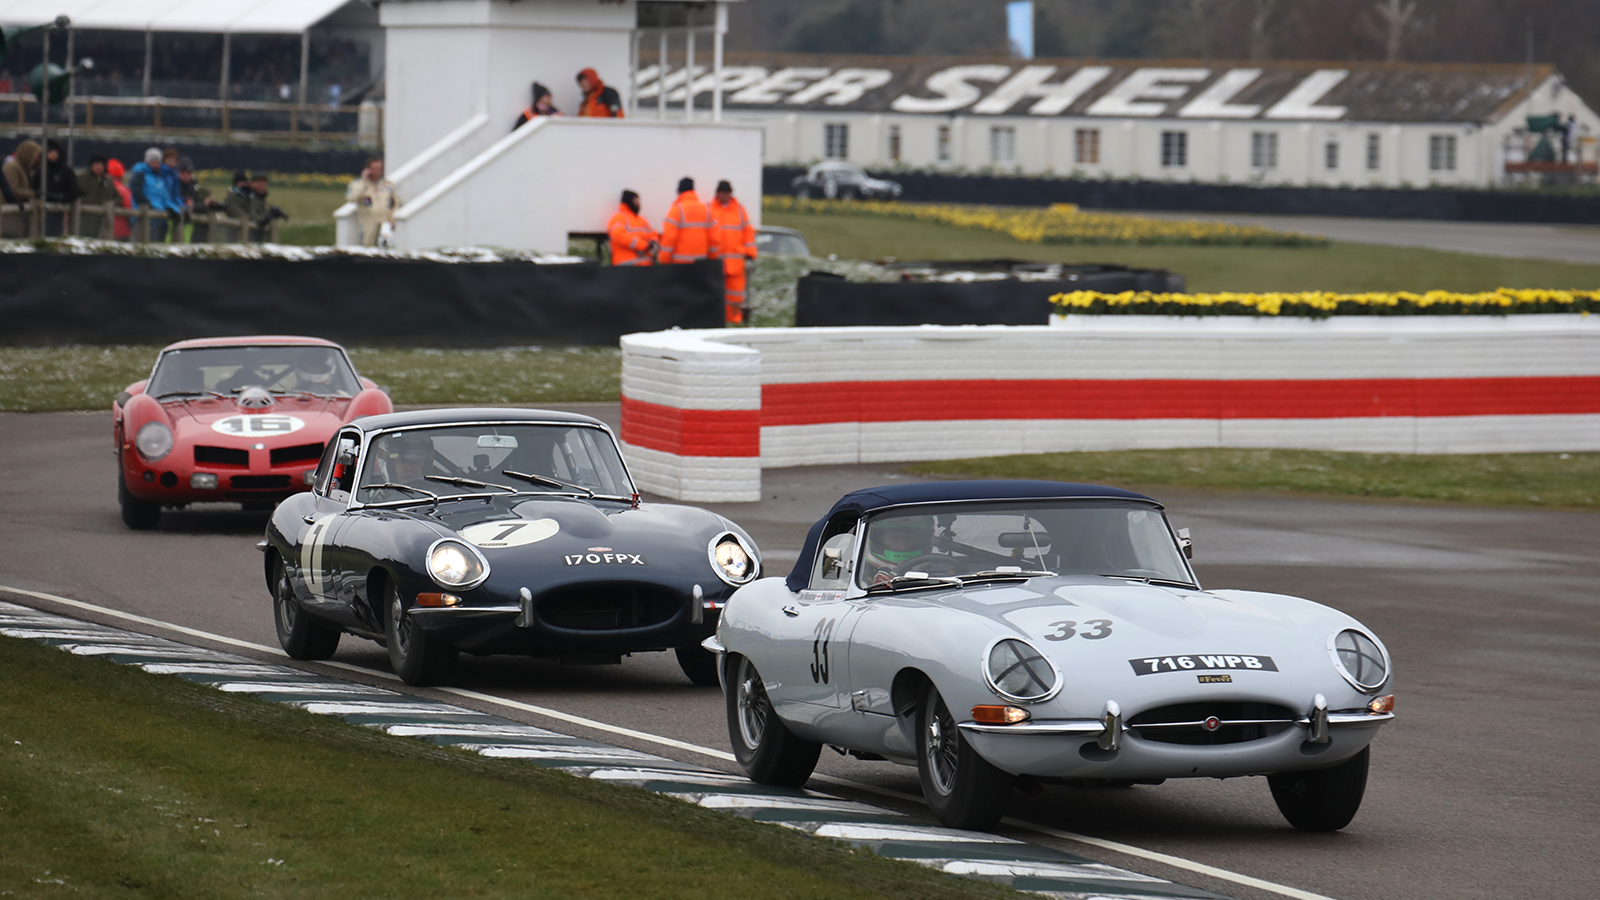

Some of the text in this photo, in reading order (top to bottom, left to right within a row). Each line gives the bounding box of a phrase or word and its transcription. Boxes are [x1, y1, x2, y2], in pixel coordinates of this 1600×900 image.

[634, 64, 1350, 120] UPER SHELL
[222, 417, 291, 432] 16
[491, 523, 528, 541] 7
[1043, 618, 1113, 642] 33
[810, 617, 836, 685] 33
[1143, 655, 1263, 672] 716 WPB
